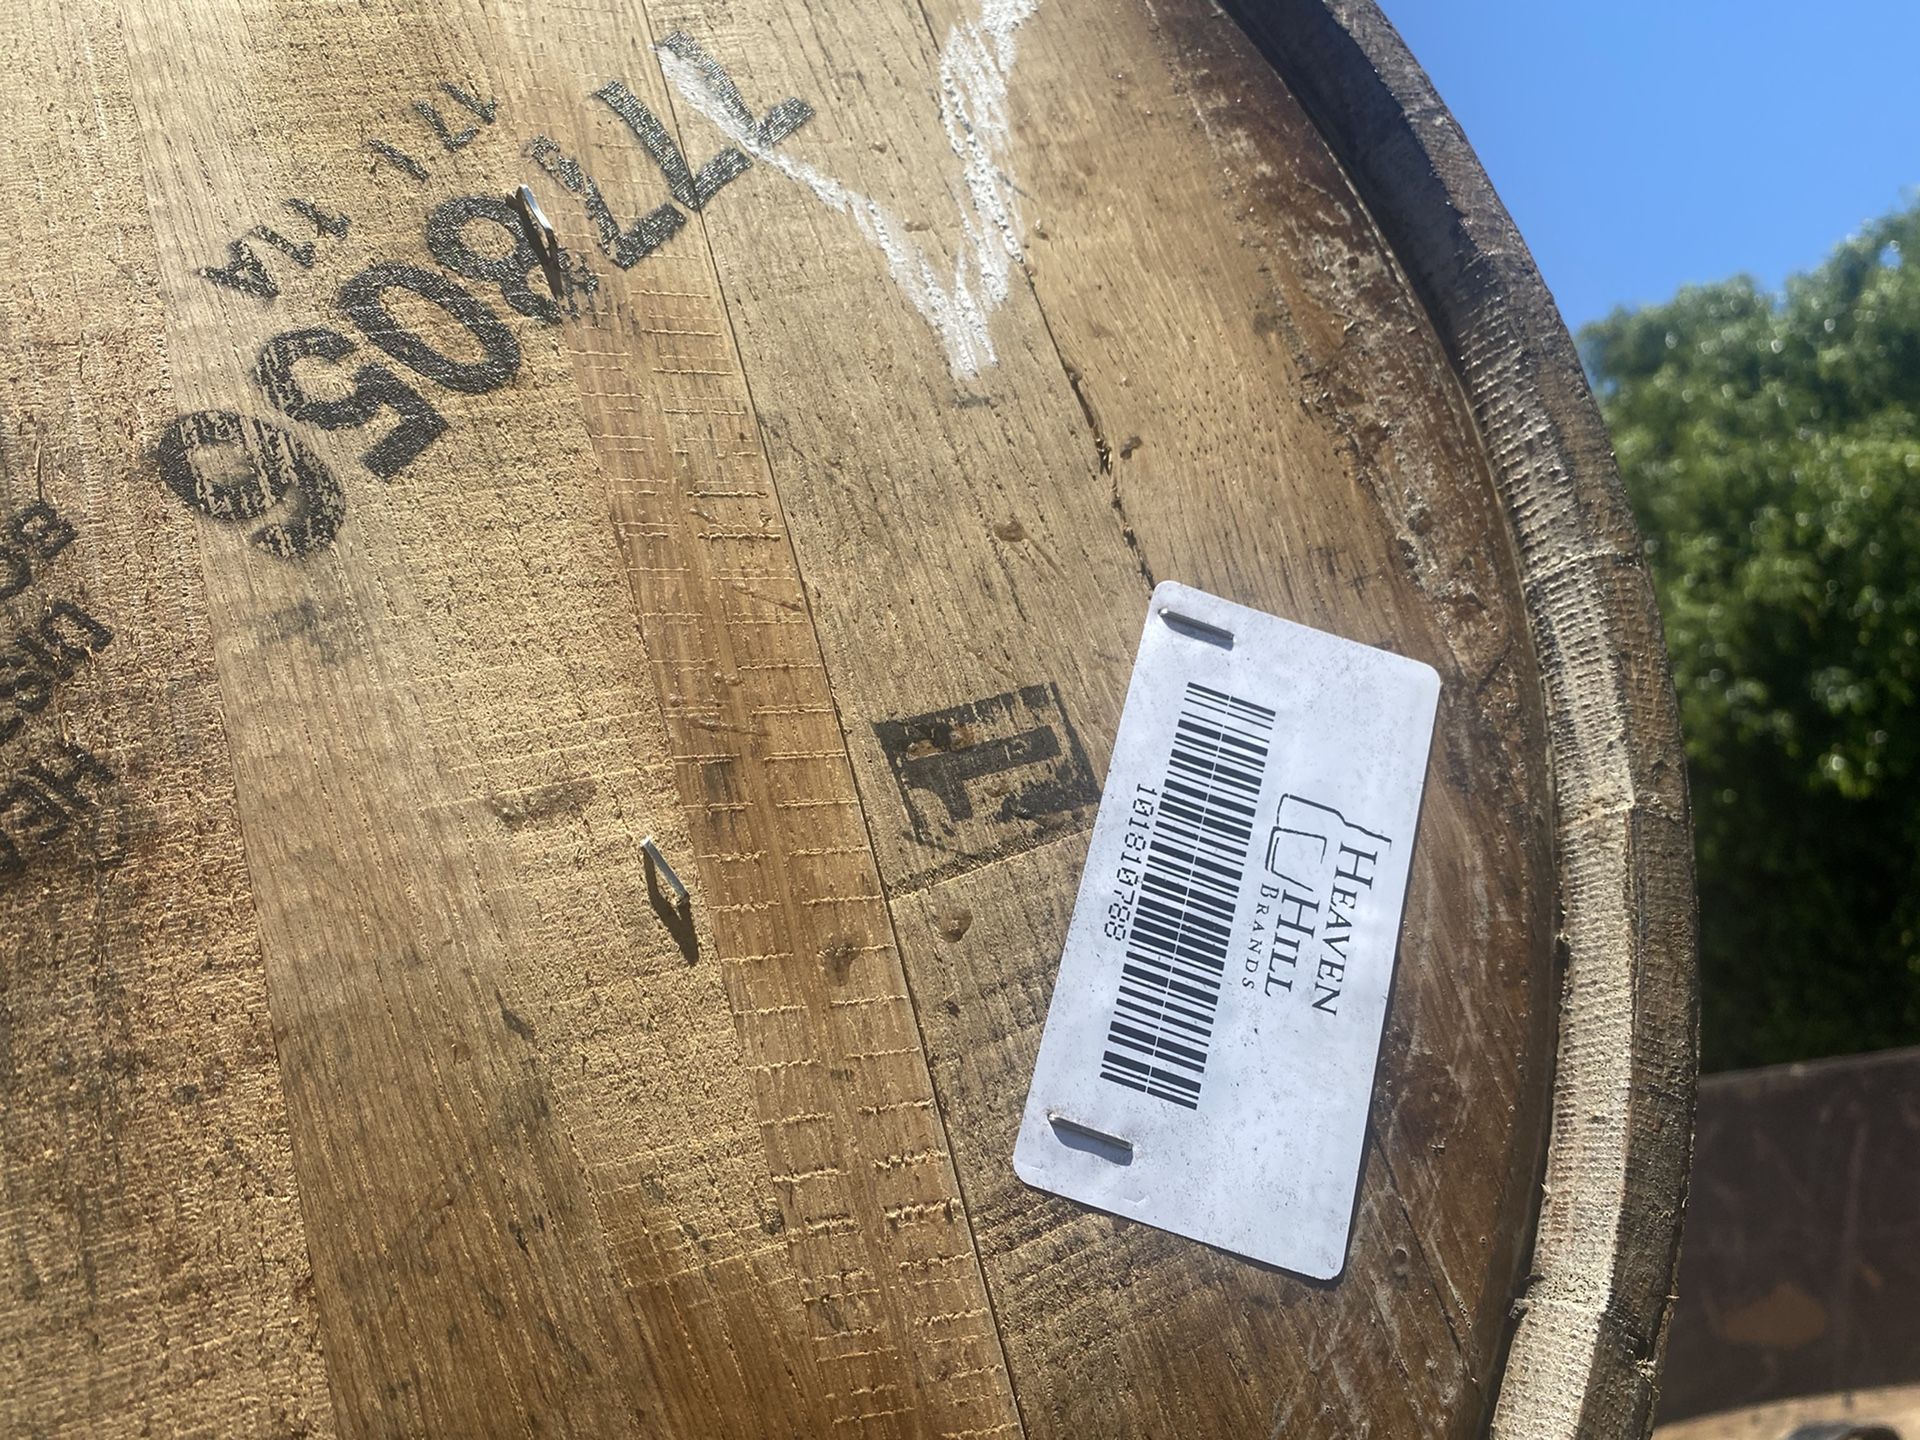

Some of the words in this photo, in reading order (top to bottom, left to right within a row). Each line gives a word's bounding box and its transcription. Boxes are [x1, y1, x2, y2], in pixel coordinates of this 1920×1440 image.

[157, 31, 814, 560] 7778056
[1103, 783, 1158, 941] 101810788
[1240, 882, 1279, 989] BRANDS
[1312, 842, 1378, 1016] HEAVEN
[1264, 889, 1320, 997] HILL
